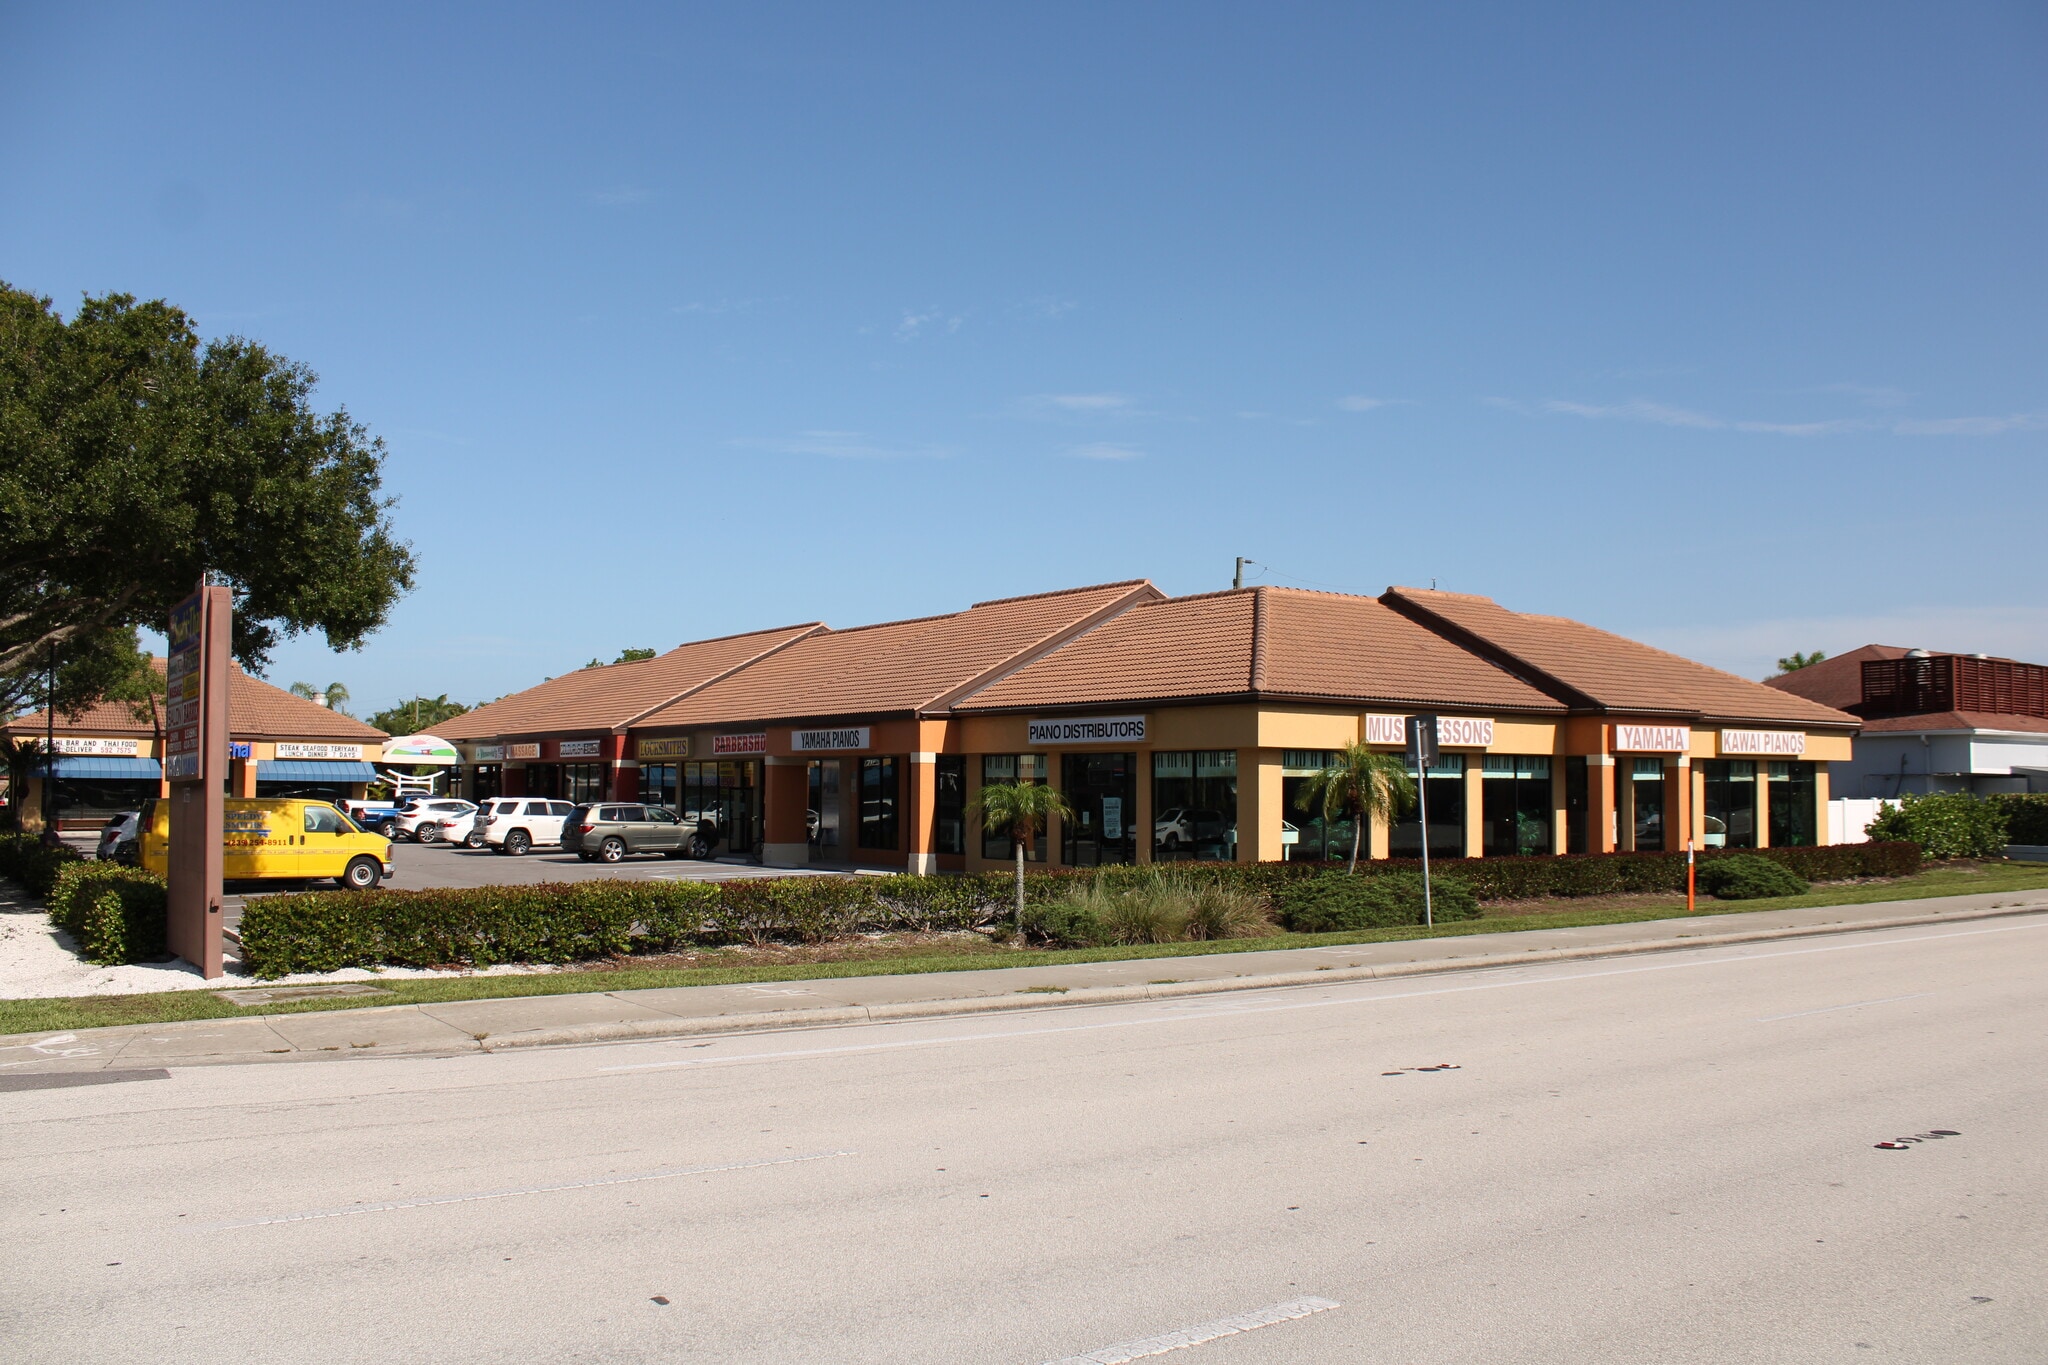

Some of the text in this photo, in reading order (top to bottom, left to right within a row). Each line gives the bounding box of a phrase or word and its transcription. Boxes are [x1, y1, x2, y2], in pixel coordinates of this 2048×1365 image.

[801, 729, 860, 749] YAMAHA PIANOS
[1029, 720, 1144, 740] PIANO DISTRIBUTORS
[1368, 717, 1492, 744] MUS ESSONS
[1623, 726, 1684, 750] YAMAHA
[509, 744, 537, 757] MASSAGE
[640, 740, 687, 756] LOCKSMITHS
[714, 734, 766, 753] BARBERSHO
[1723, 732, 1804, 753] KAWAI PIANOS
[224, 821, 263, 829] SMITHS
[228, 839, 248, 847] (239)
